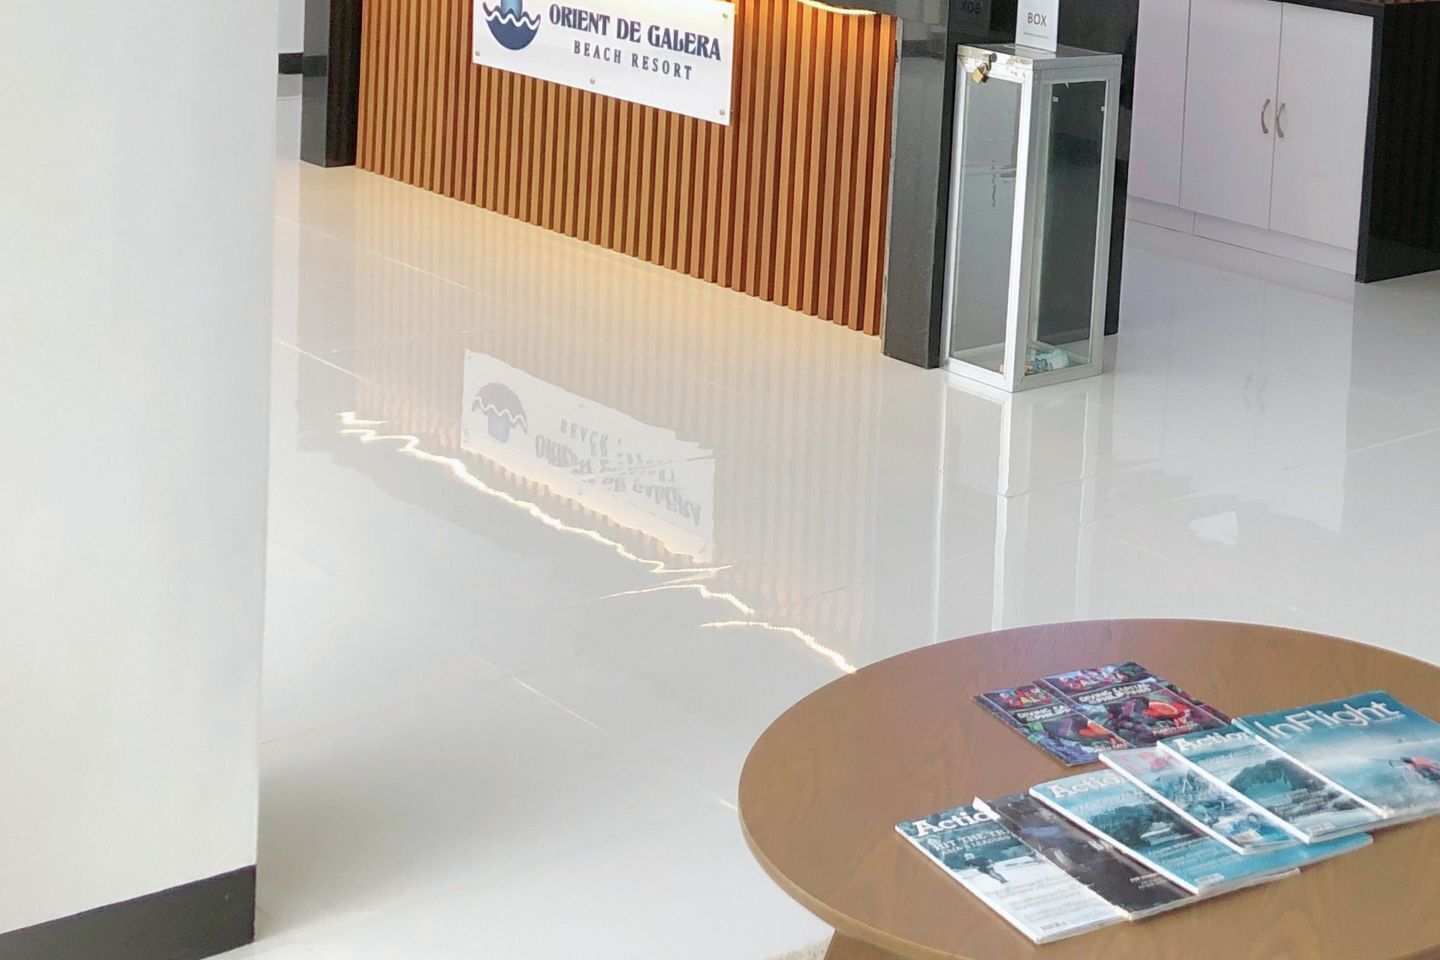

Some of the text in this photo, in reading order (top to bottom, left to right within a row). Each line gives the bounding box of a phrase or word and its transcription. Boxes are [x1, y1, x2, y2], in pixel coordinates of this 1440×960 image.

[550, 3, 721, 61] ORIENT DE GALERA
[1027, 12, 1046, 26] BOX
[574, 41, 693, 81] BEACH RESORT
[1254, 701, 1399, 739] InFlight
